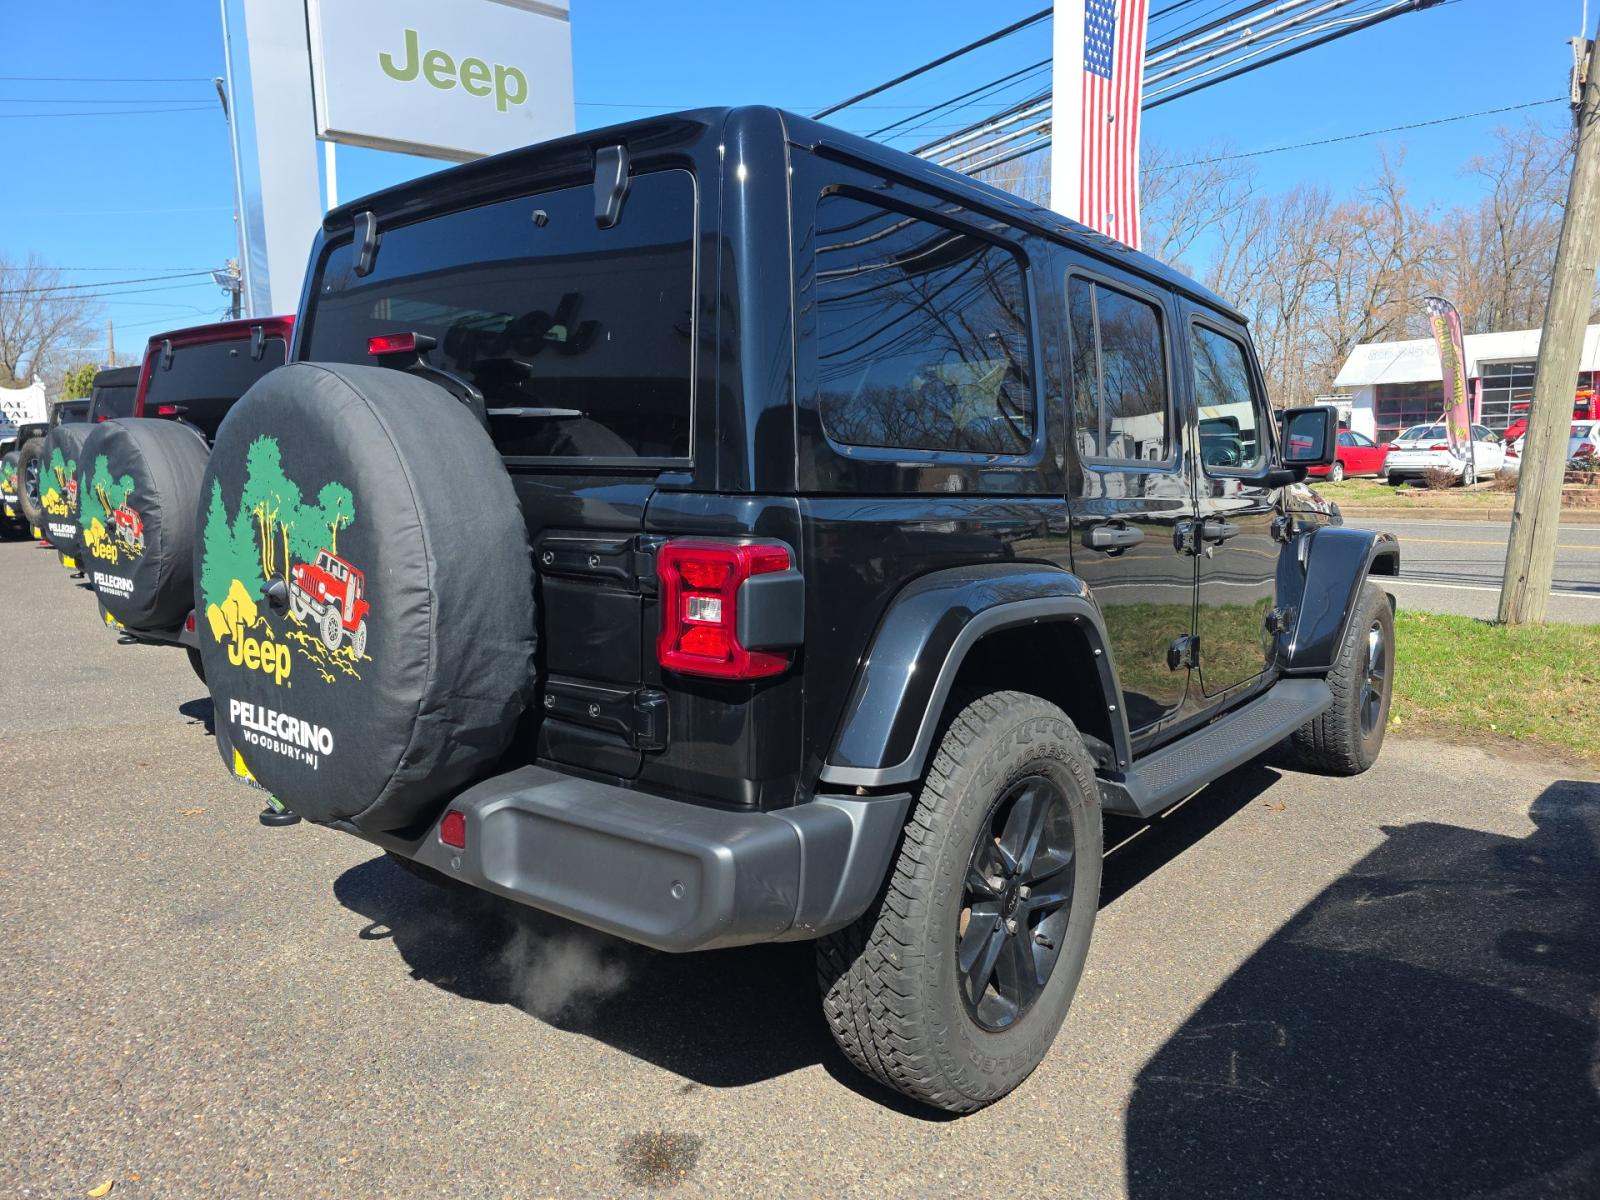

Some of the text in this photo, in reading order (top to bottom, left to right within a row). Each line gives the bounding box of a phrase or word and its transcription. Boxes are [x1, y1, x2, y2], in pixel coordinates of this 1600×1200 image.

[378, 28, 529, 112] Jeep
[47, 501, 69, 518] Jeep
[92, 538, 118, 565] Jeep
[93, 571, 134, 592] PELLEGRINO
[227, 624, 292, 685] Jeep
[230, 699, 334, 755] PELLEGRINO
